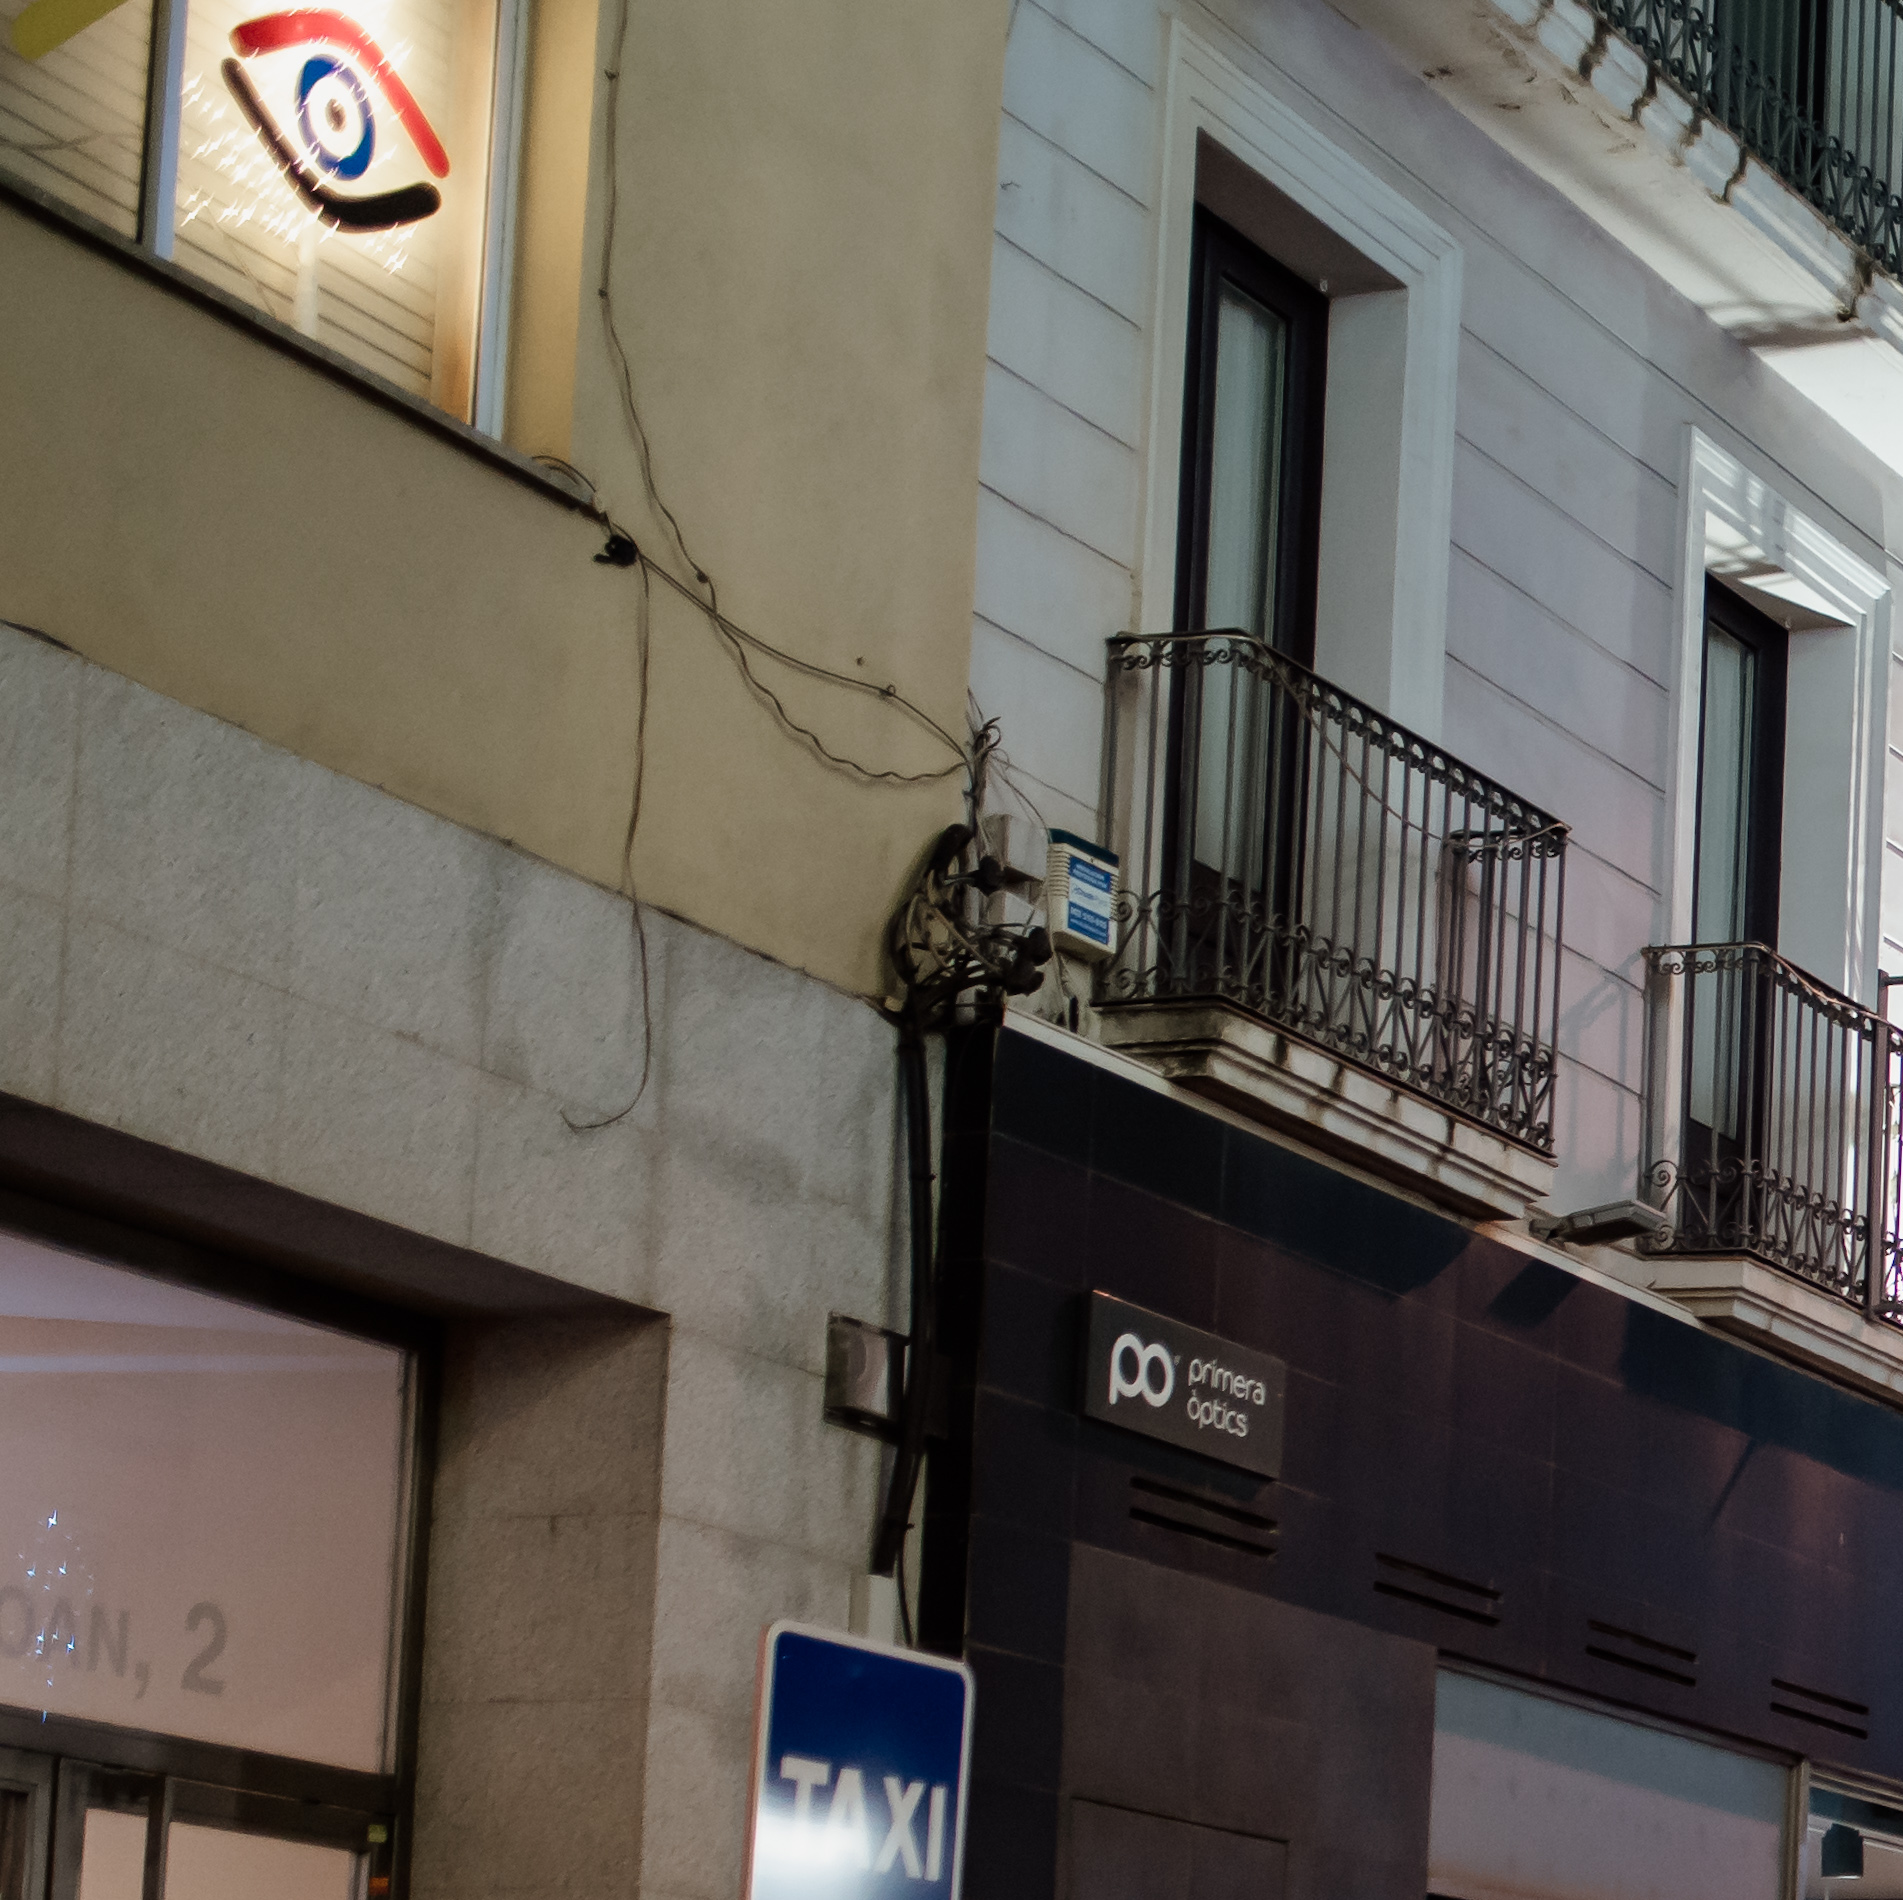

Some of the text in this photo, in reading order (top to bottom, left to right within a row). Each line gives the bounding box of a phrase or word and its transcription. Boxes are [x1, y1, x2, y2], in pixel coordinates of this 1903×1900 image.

[1187, 1389, 1249, 1438] òptics
[1188, 1358, 1267, 1406] primera
[180, 1601, 229, 1698] 2
[780, 1756, 948, 1884] TAXI
